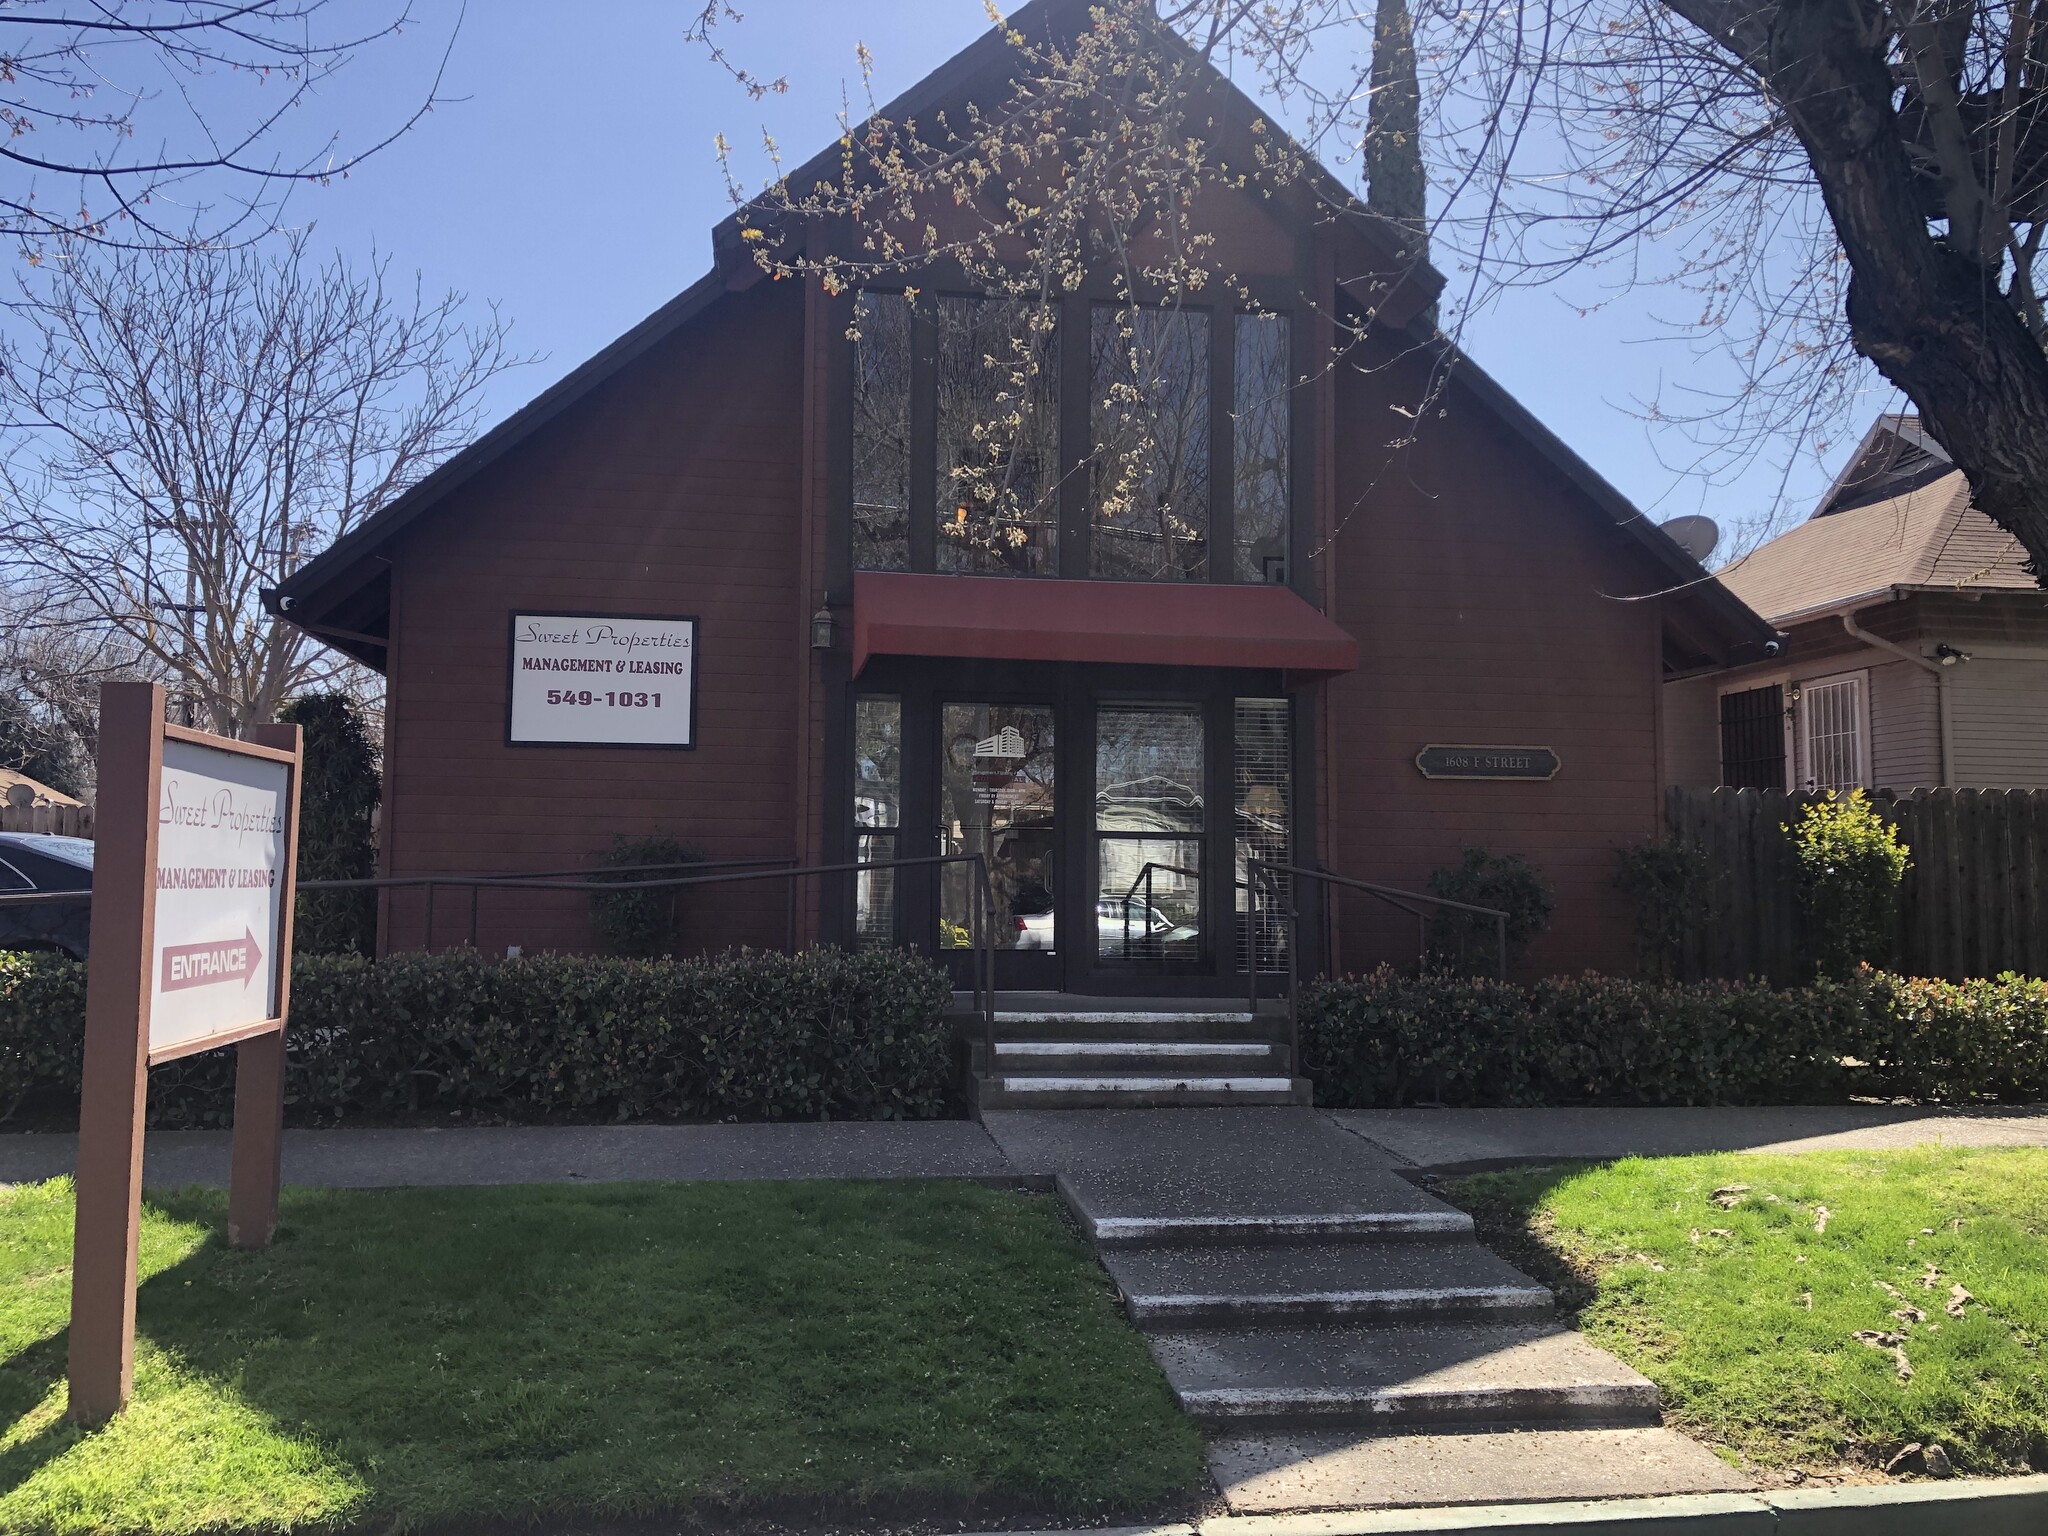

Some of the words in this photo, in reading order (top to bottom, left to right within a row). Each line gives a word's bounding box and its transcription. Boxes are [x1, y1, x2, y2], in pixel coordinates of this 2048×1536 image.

[515, 622, 580, 644] Sweet
[585, 625, 691, 655] Properties
[522, 657, 613, 673] MANAGEMENT
[615, 660, 626, 674] &
[629, 660, 683, 675] LEASING
[546, 689, 662, 708] 549-1031
[1445, 756, 1469, 768] 1608
[1485, 756, 1532, 769] STREET
[159, 780, 207, 827] Sweet
[211, 788, 283, 848] Properties
[156, 867, 228, 889] MANAGEMENT
[228, 870, 237, 889] &
[237, 869, 275, 889] LEASING
[170, 947, 247, 981] ENTRANCE
